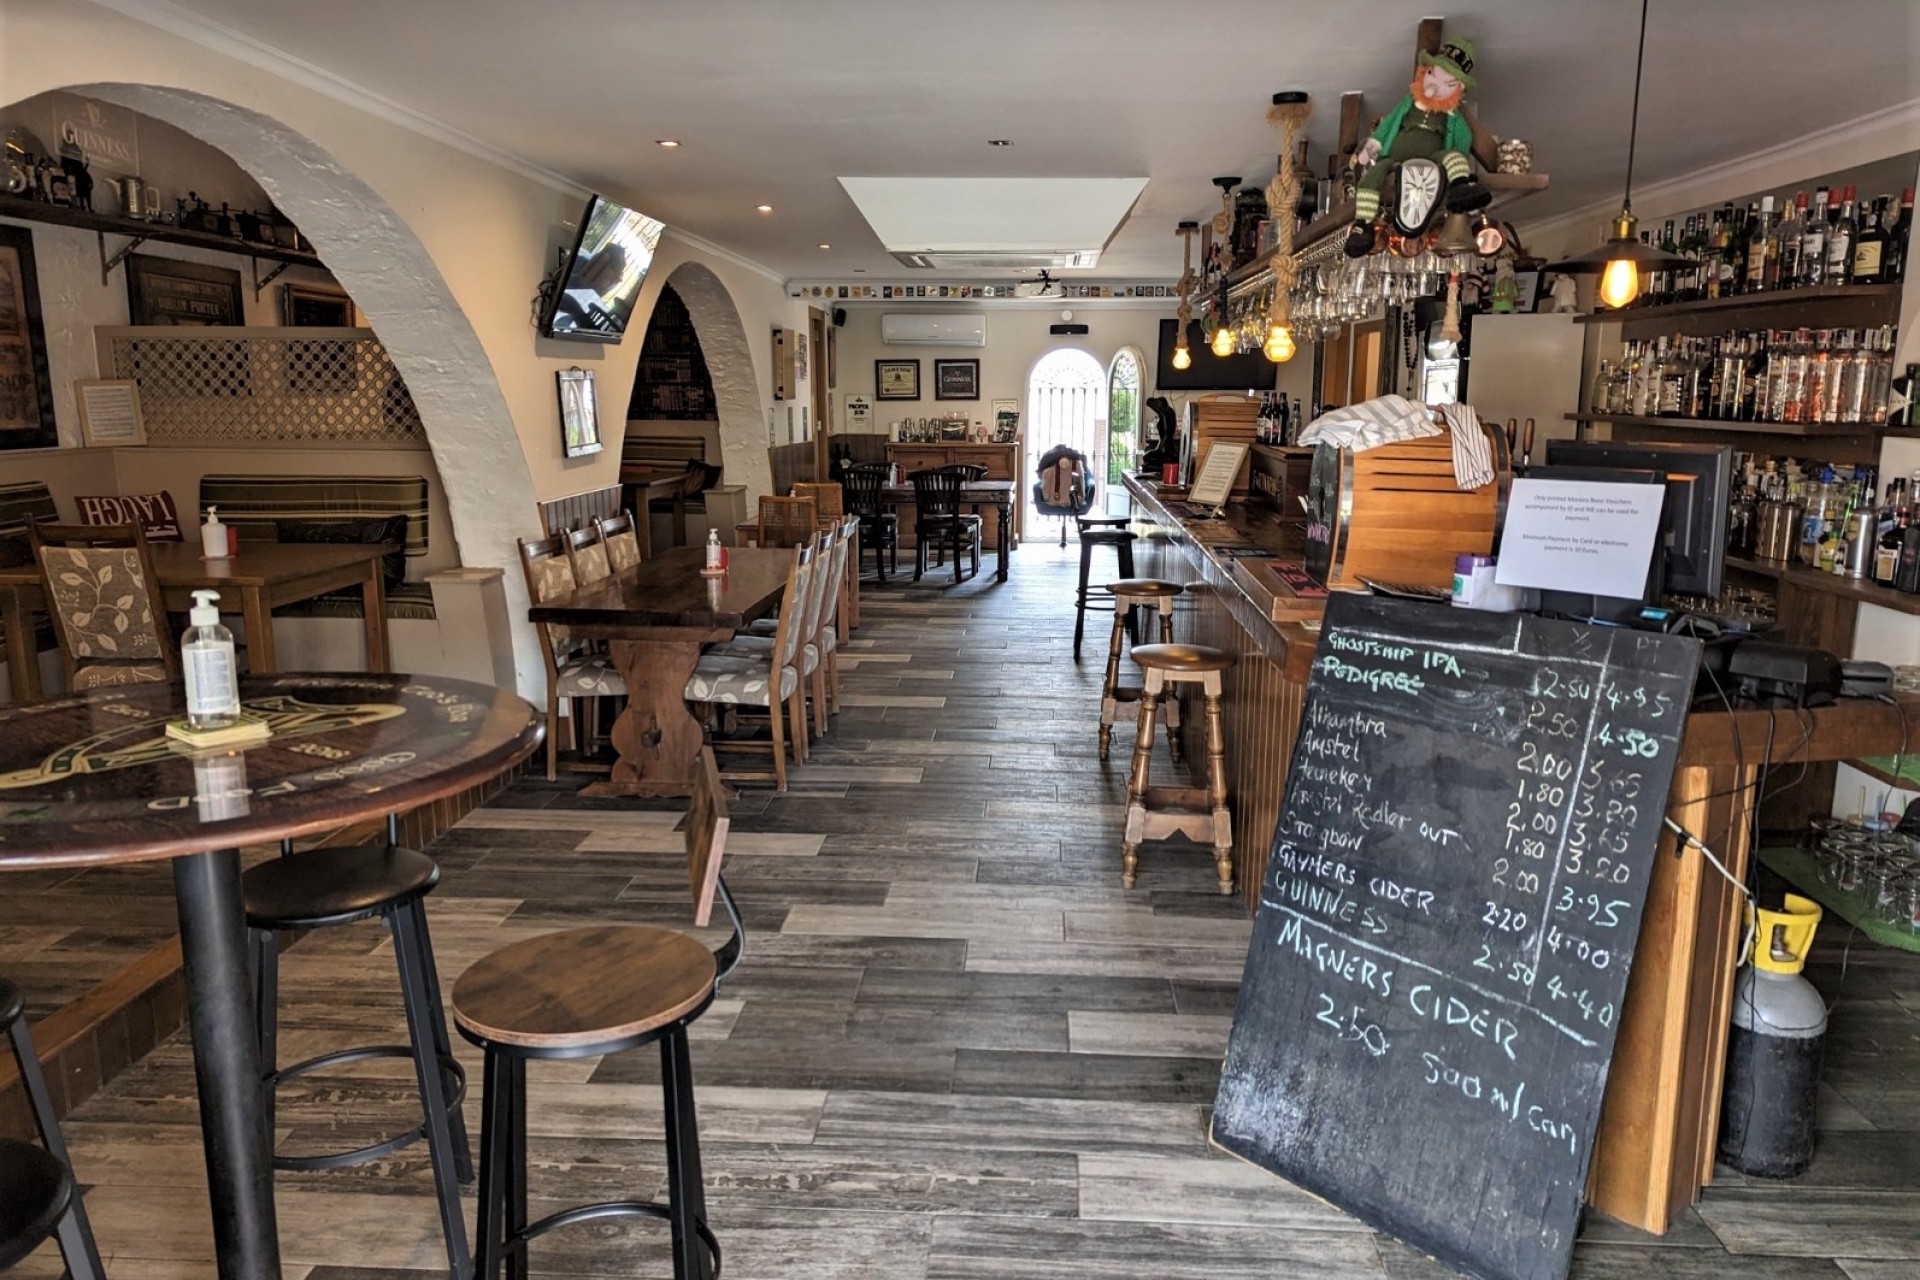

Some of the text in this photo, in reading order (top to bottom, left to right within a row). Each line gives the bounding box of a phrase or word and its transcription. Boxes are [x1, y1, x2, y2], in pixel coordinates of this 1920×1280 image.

[1328, 631, 1414, 662] GHOSTSHIP
[1303, 729, 1361, 763] Amstel
[1275, 869, 1389, 934] GUINNESS
[1409, 984, 1520, 1062] CIDER
